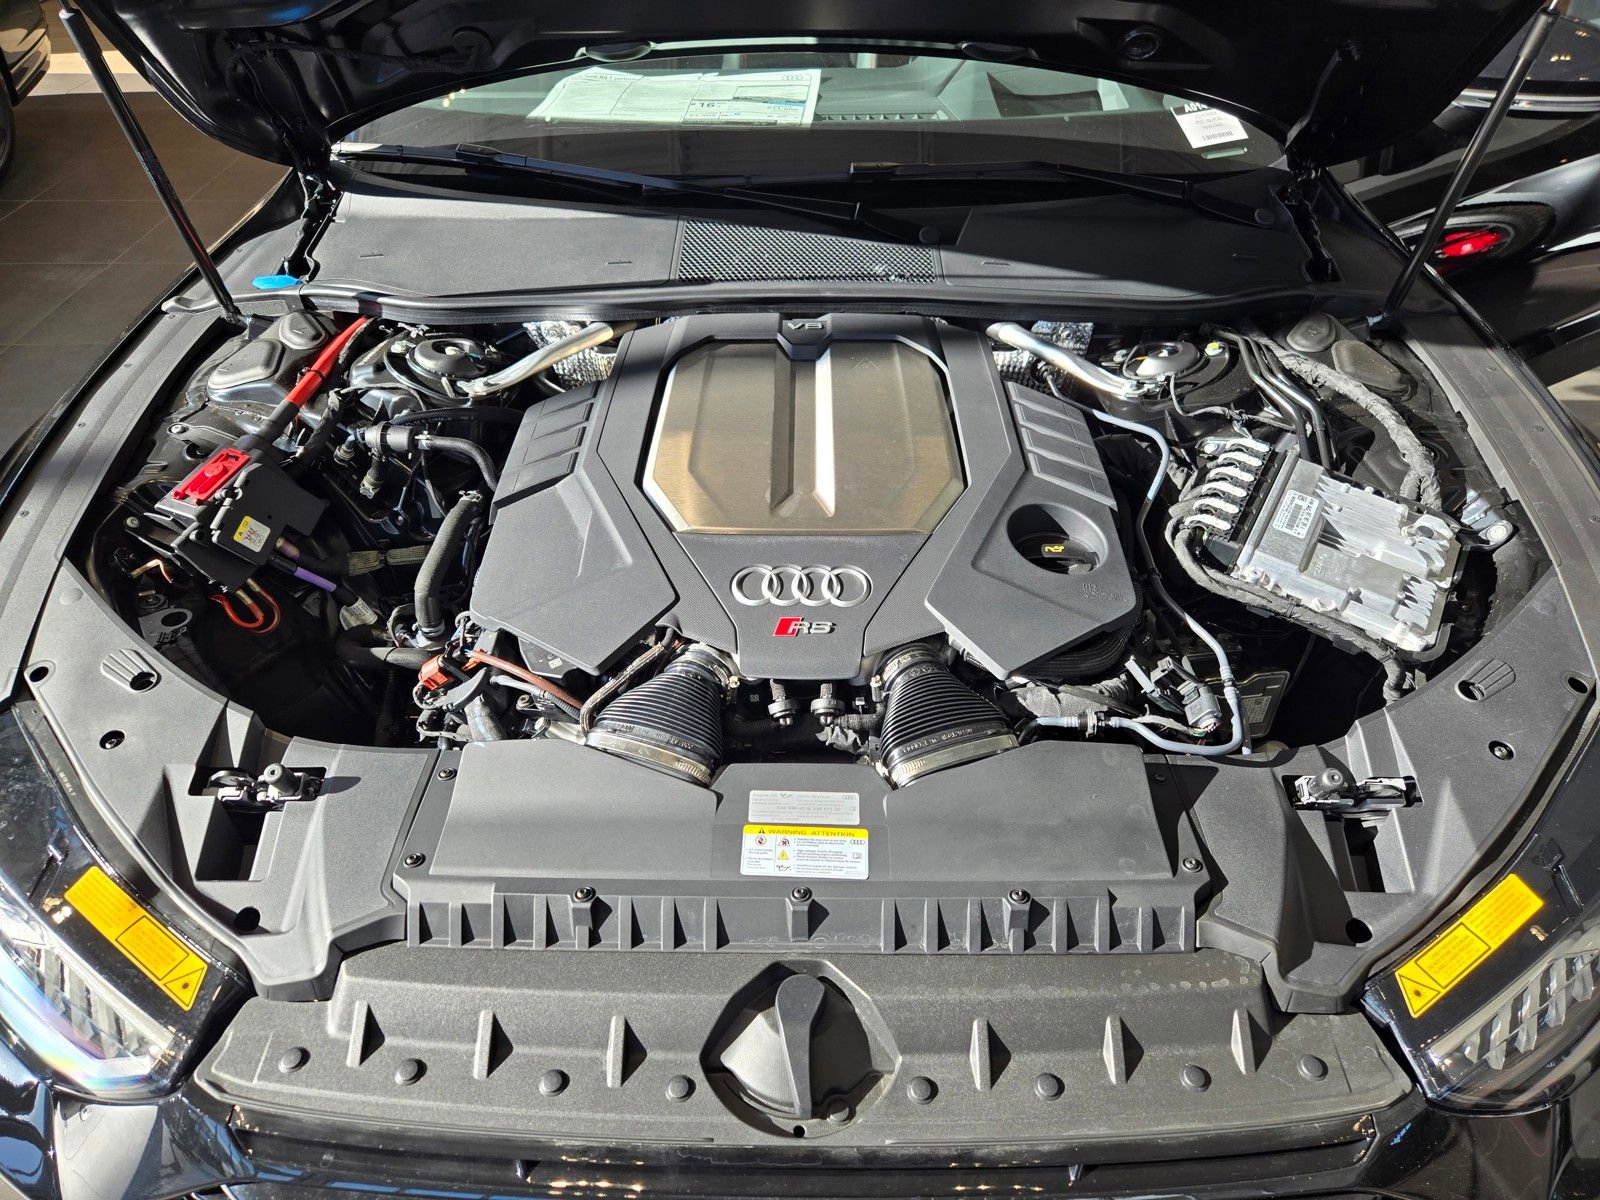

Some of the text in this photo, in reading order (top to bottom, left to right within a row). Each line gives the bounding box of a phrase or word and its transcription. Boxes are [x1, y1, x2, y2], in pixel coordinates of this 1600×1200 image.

[787, 322, 823, 330] V8
[768, 828, 855, 837] WARNING ATTENTION
